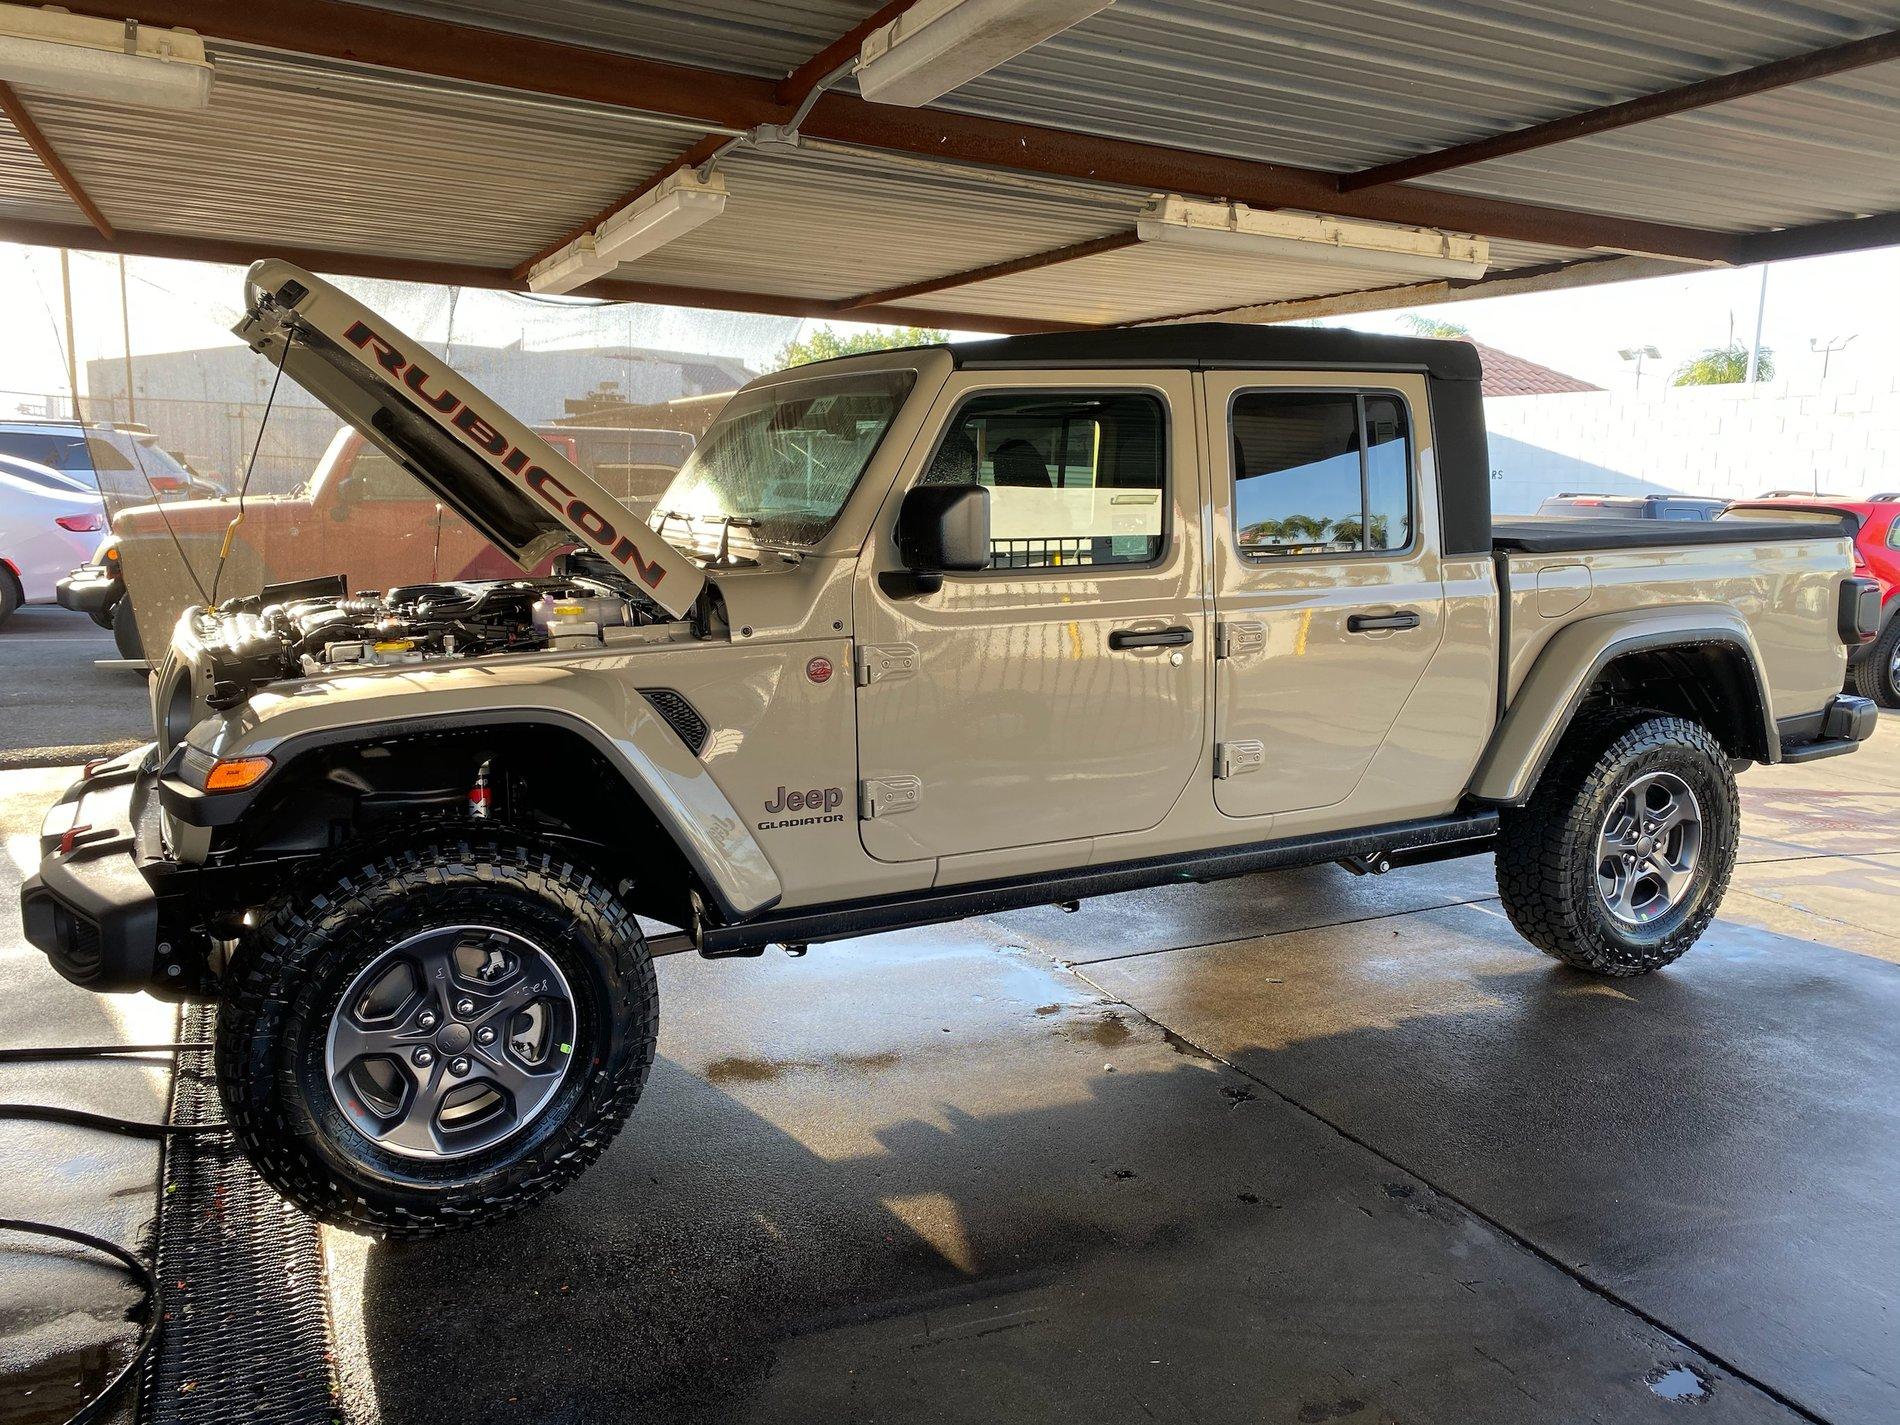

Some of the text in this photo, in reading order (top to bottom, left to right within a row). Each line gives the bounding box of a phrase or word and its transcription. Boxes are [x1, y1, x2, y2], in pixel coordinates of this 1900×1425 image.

[344, 320, 666, 588] RUBICON
[765, 786, 843, 813] Jeep
[758, 815, 844, 830] GLADIATOR
